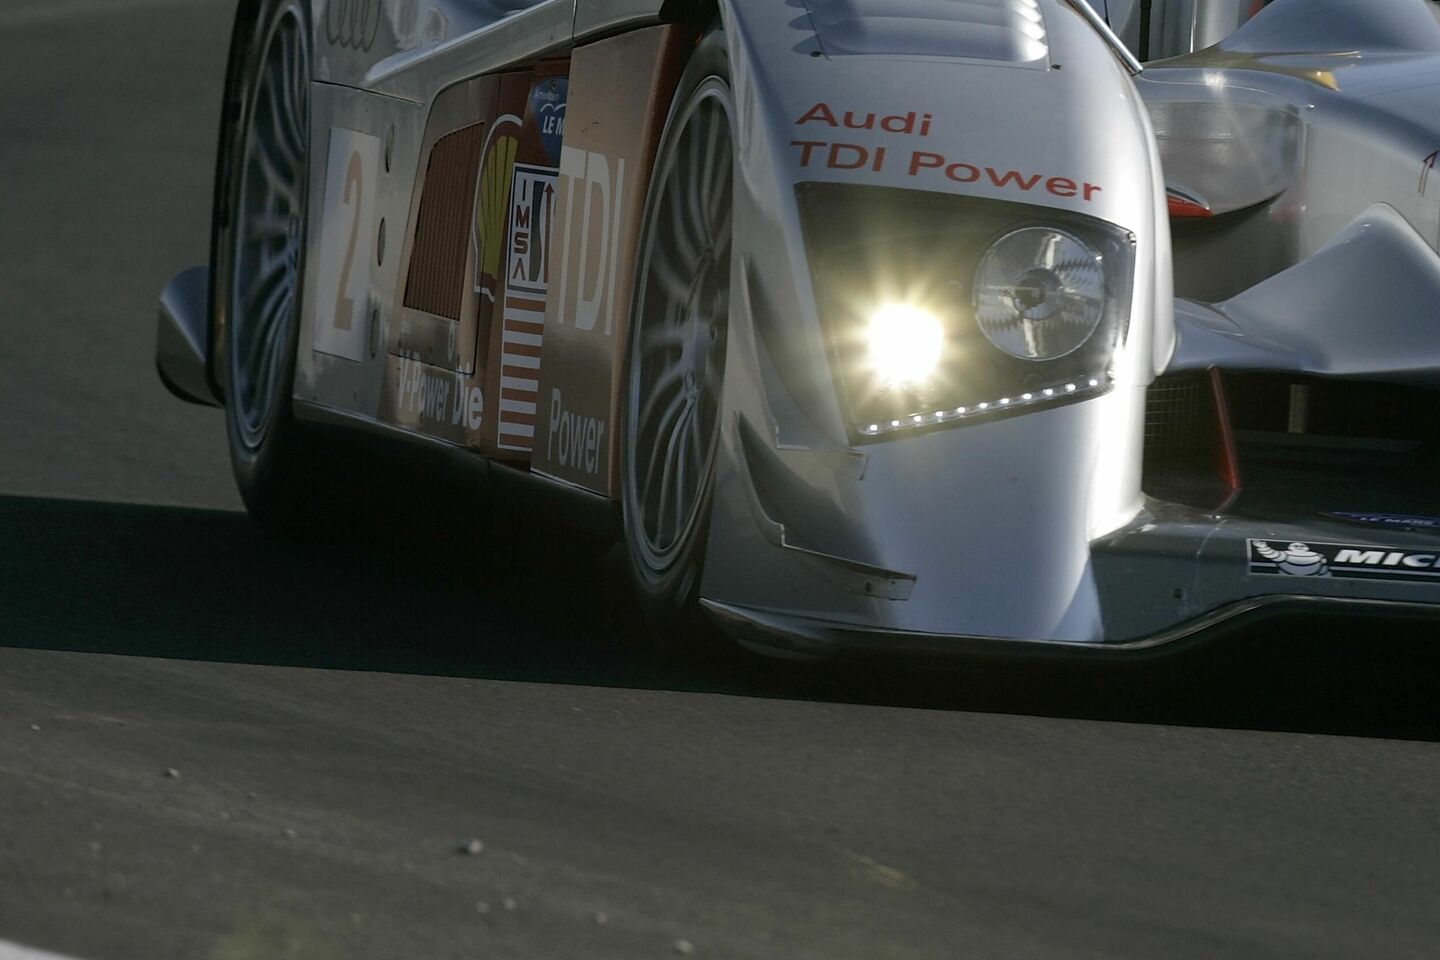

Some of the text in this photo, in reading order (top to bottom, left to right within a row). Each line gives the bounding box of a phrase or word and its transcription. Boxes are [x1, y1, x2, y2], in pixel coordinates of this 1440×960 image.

[795, 102, 933, 137] Audi
[790, 141, 1103, 201] TDI Power
[333, 150, 363, 331] 2
[557, 145, 625, 336] TDI
[547, 388, 605, 474] Power
